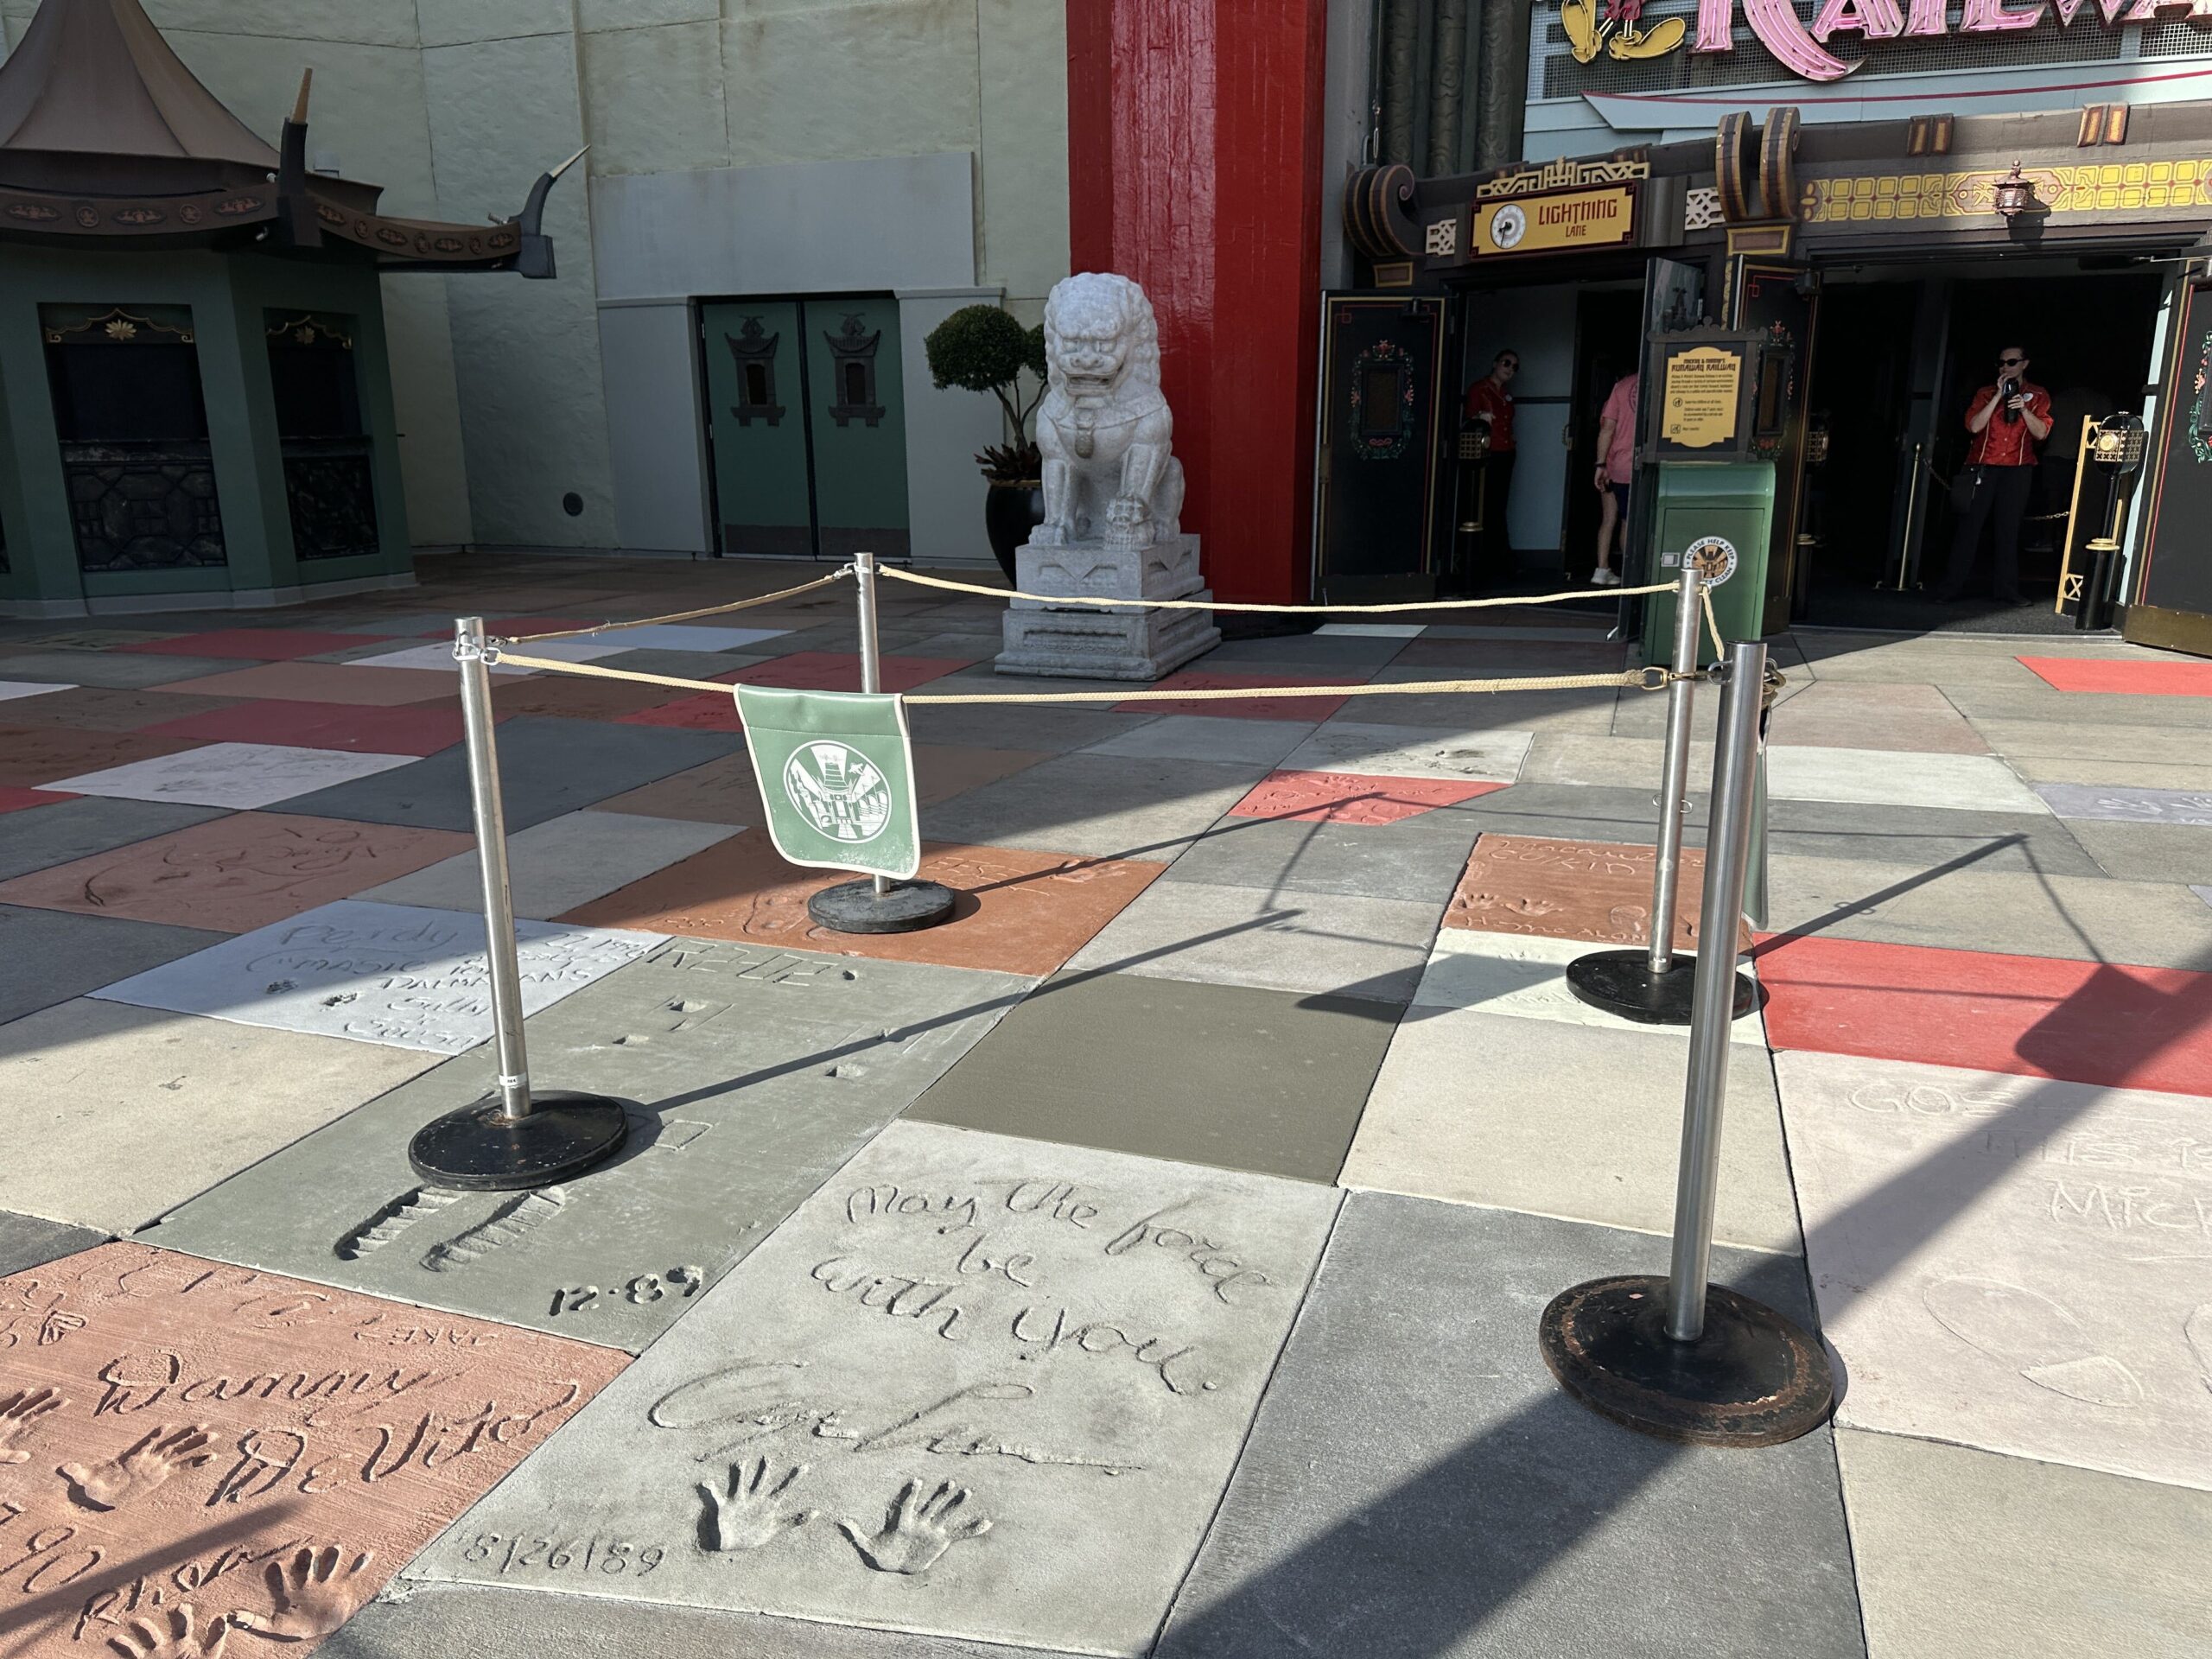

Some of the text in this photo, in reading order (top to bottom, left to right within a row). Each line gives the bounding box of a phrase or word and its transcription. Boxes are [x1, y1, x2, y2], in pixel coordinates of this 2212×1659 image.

[1688, 0, 2212, 81] AIL
[1539, 199, 1618, 226] LIGHTNING
[1565, 225, 1586, 238] LANE
[1706, 363, 1736, 372] RAILWAY
[1687, 541, 1705, 559] PLEASE
[1725, 544, 1735, 560] KEEP
[1715, 567, 1732, 583] CLEAN
[378, 969, 591, 990] DALMAANS
[957, 1235, 1035, 1287] be
